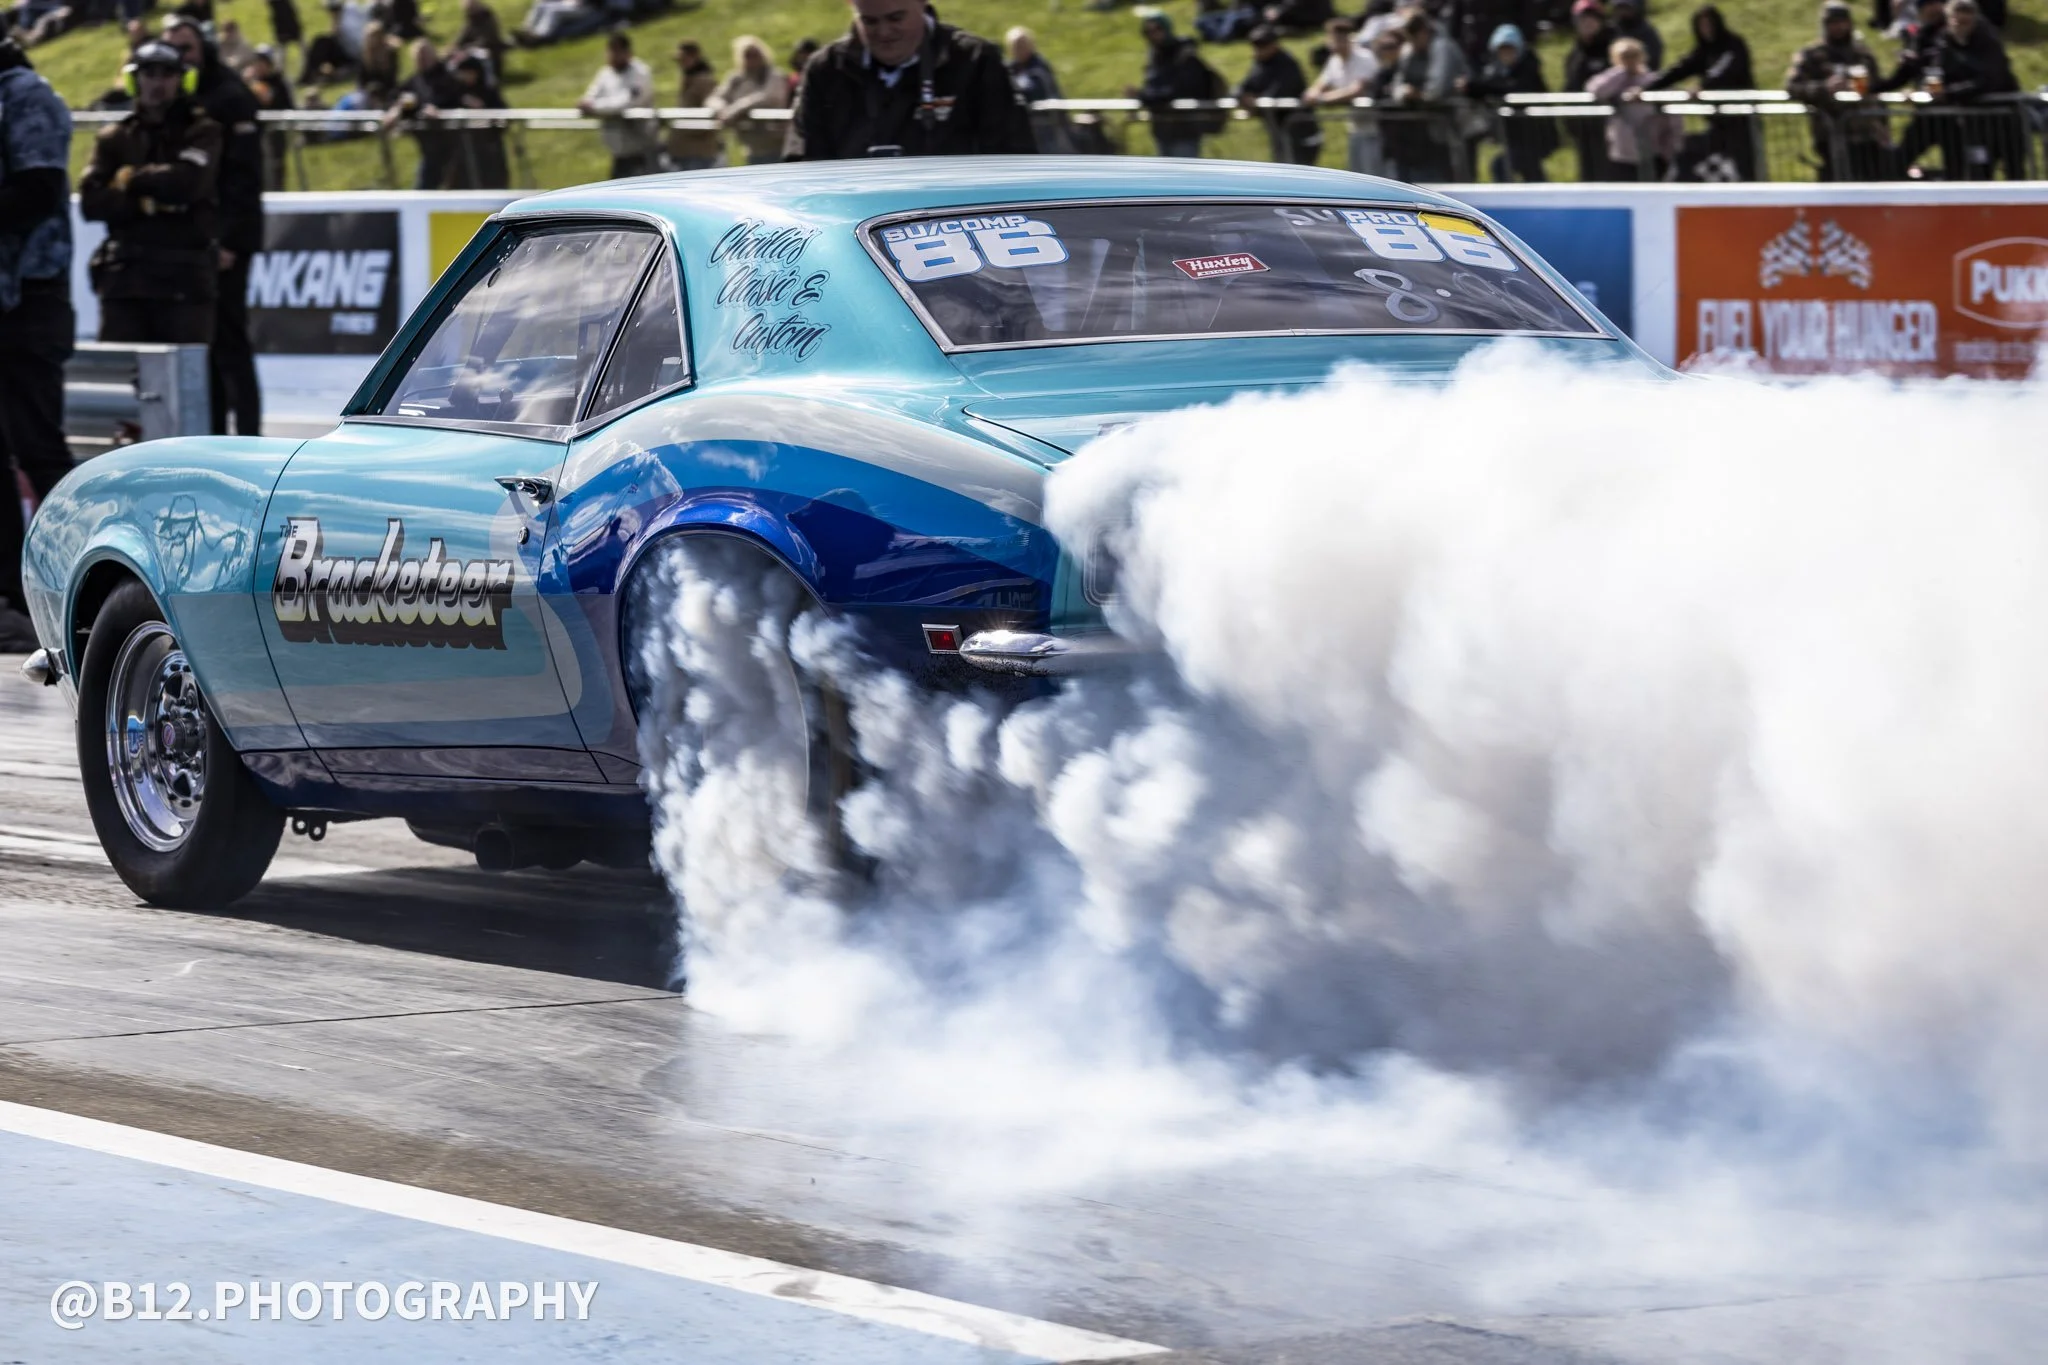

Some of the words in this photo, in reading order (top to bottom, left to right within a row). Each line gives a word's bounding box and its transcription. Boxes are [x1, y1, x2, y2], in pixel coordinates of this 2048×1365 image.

[882, 214, 1028, 243] SU/COMP
[888, 220, 1071, 282] 86
[1347, 217, 1518, 272] 86
[716, 264, 799, 308] Classic
[789, 272, 828, 308] &
[1186, 256, 1254, 271] Huxley
[731, 311, 829, 360] Custom
[1759, 300, 1829, 360] YOUR
[1833, 300, 1937, 362] HUNGER
[280, 525, 299, 538] THE
[268, 516, 514, 640] Bracketeer
